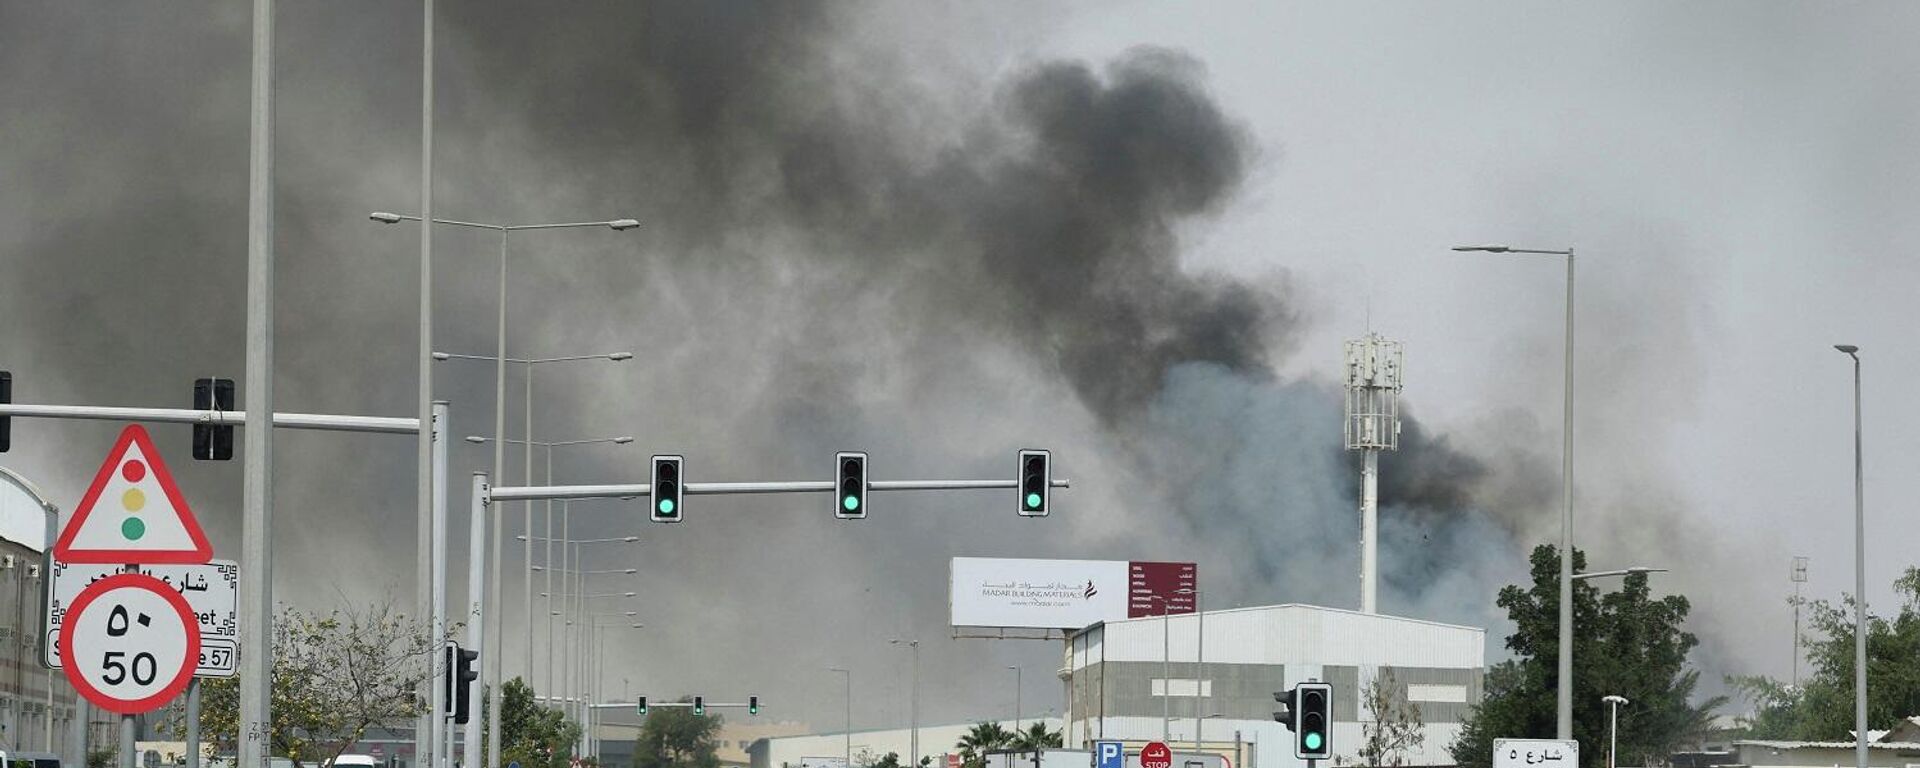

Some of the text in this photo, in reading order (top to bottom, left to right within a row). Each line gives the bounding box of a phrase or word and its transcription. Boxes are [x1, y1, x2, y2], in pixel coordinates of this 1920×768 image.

[1043, 591, 1084, 599] MATERIALS
[107, 604, 151, 637] ٥٠
[194, 609, 216, 625] eet
[211, 650, 230, 666] 57
[102, 652, 157, 686] 50
[1102, 744, 1118, 764] P
[1147, 747, 1165, 758] قف
[1510, 749, 1562, 764] شارع ٥
